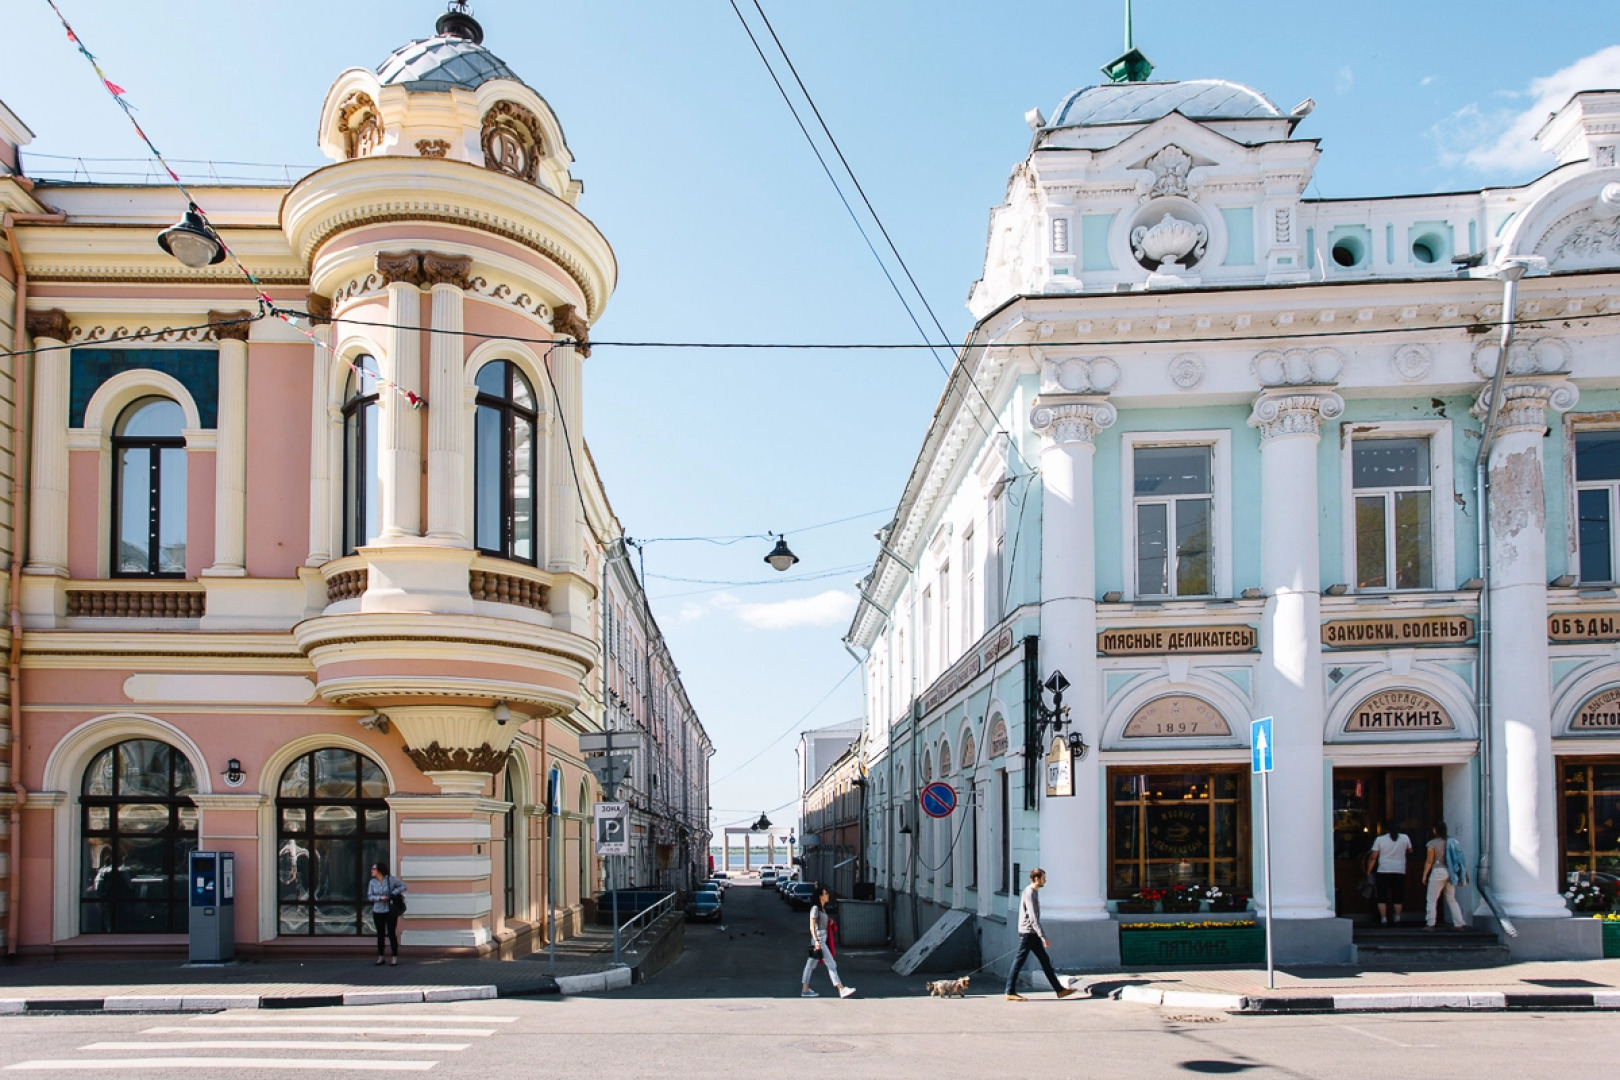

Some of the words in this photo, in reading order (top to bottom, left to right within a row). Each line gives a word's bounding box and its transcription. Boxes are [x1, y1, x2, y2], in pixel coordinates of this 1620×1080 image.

[1104, 632, 1163, 650] МЯСНЫЕ
[1168, 630, 1254, 651] ДЕЛИКАТЕСЫ
[1327, 623, 1399, 642] ЗАКУСКИ,
[1402, 620, 1468, 638] СОЛЕНЬЯ
[1156, 722, 1199, 734] 1897
[1359, 710, 1443, 727] ПЯТКИНЪ
[1158, 939, 1230, 958] ПЯТКИНЪ
